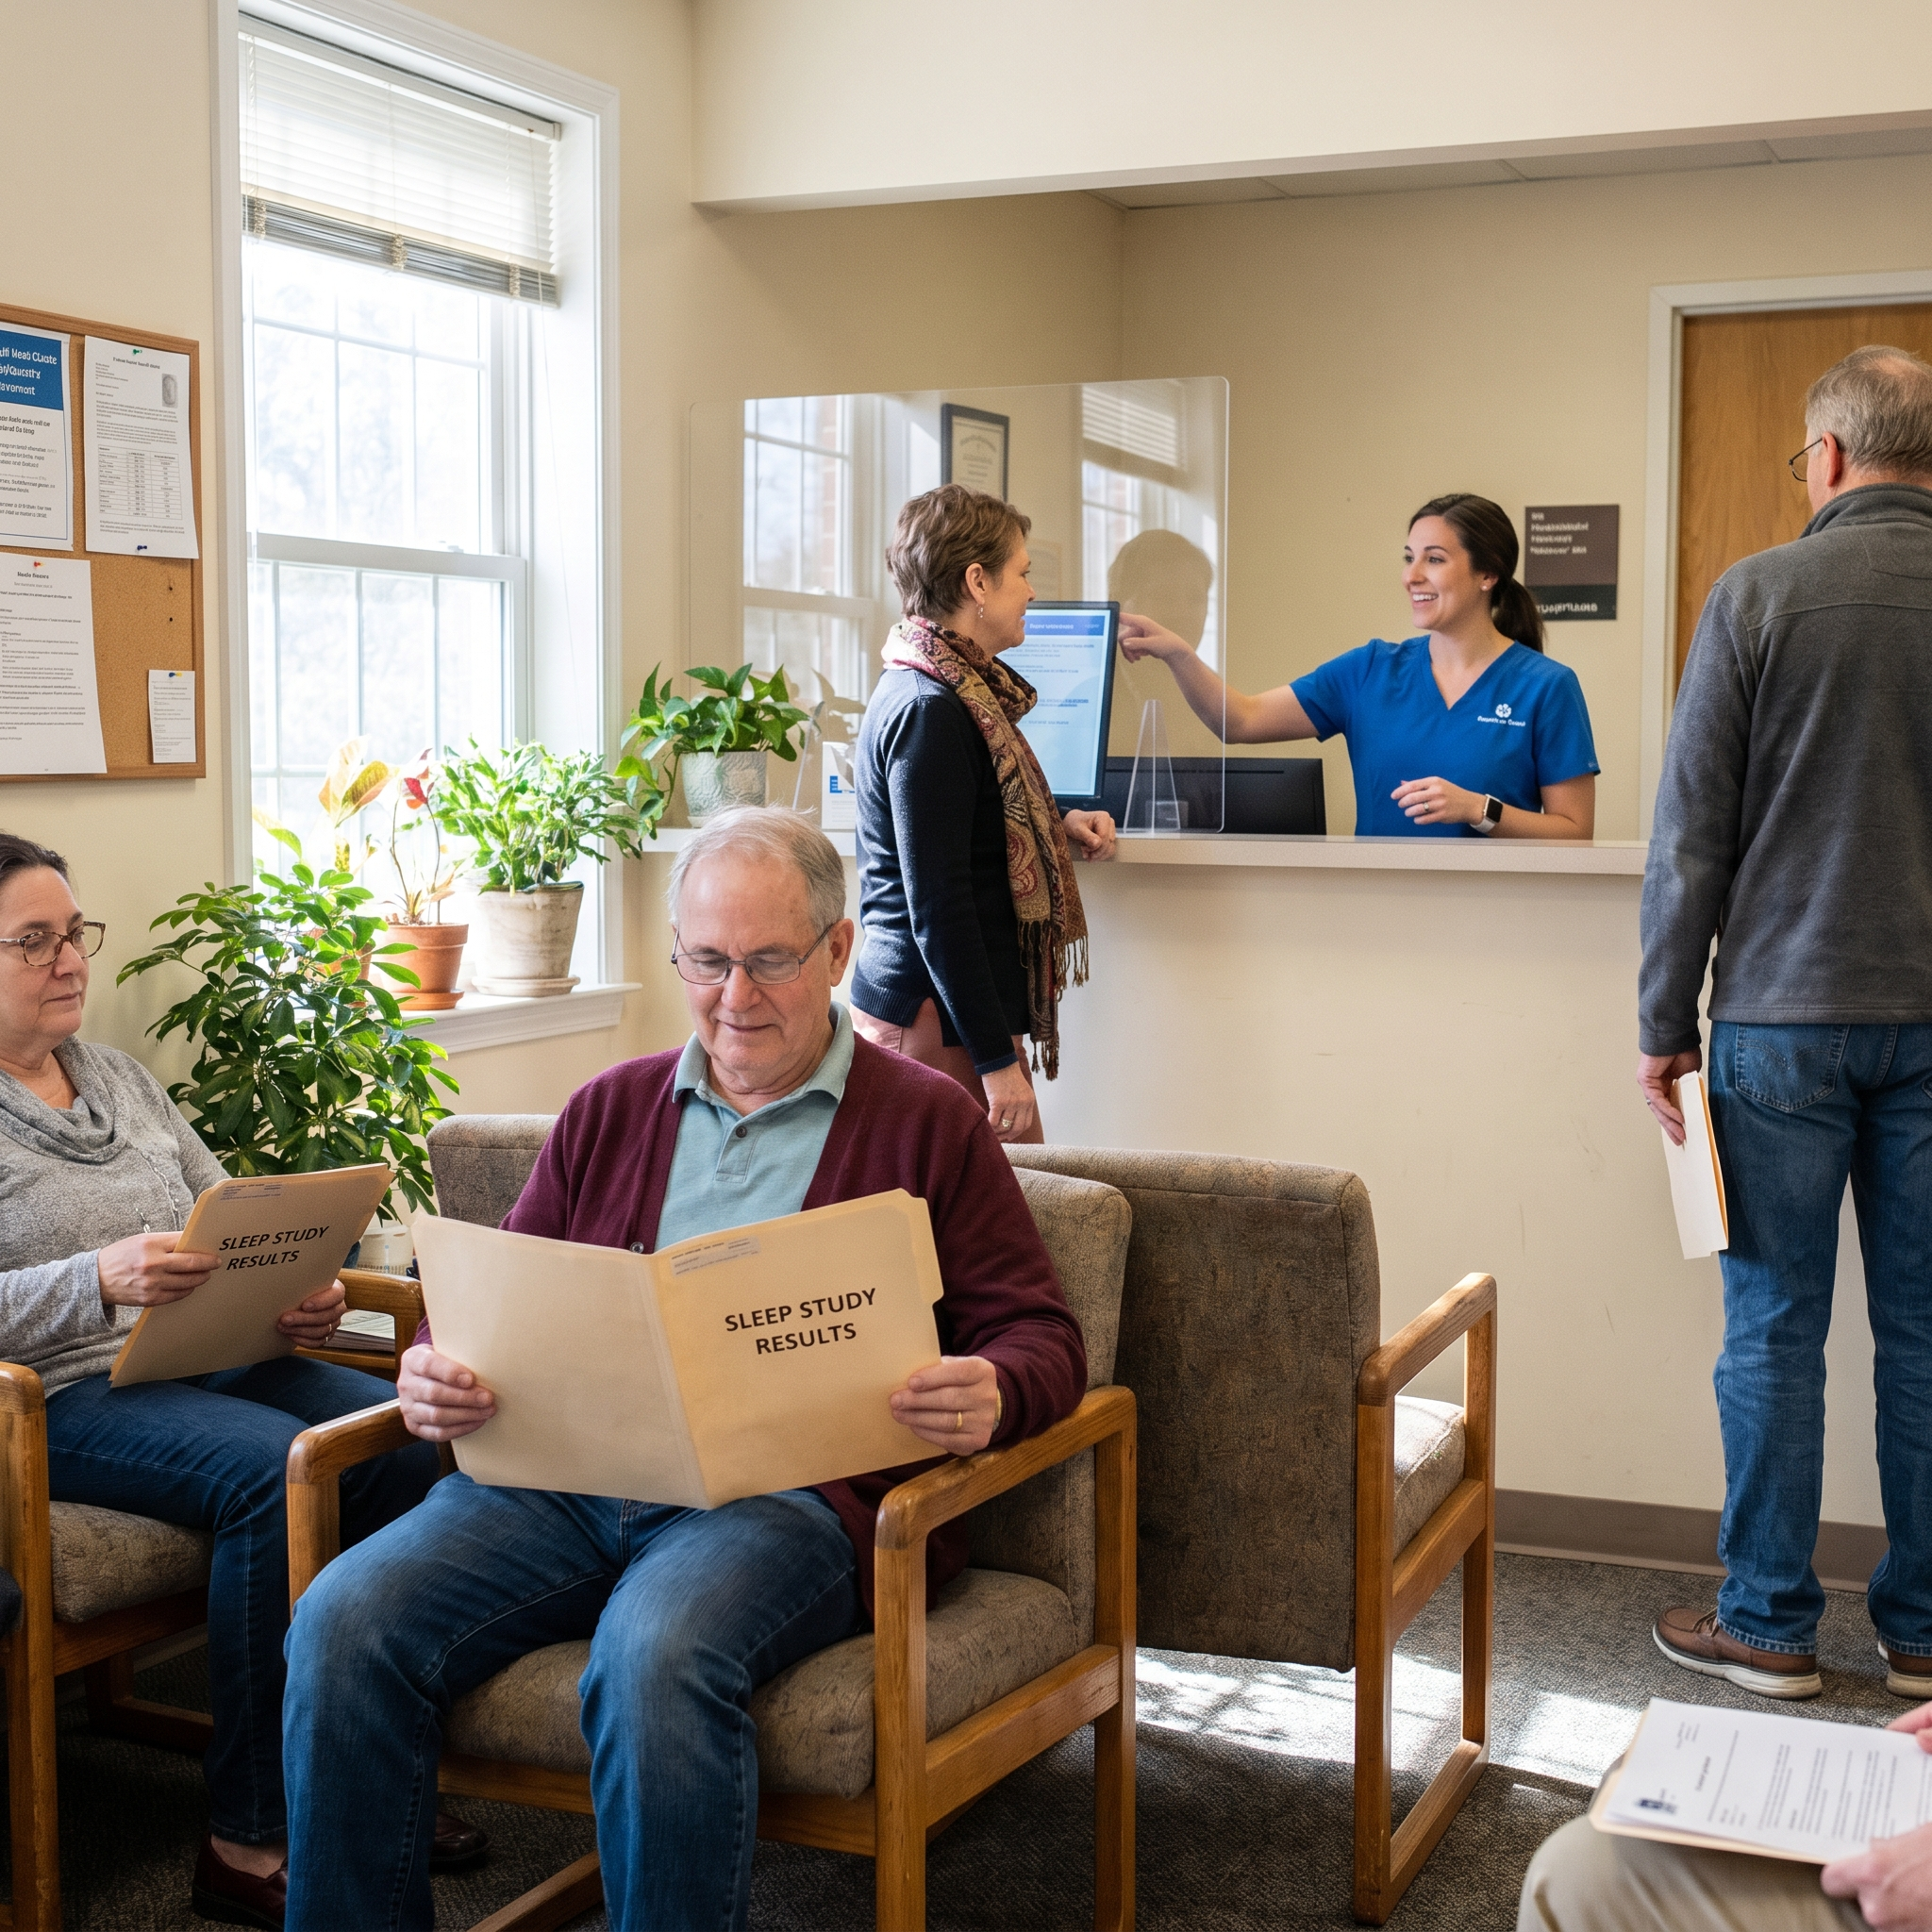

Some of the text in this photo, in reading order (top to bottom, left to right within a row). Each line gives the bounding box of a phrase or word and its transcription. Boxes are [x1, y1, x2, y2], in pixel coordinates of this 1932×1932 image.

[219, 1225, 329, 1251] SLEEP STUDY
[226, 1250, 300, 1271] RESULTS
[724, 1288, 876, 1332] SLEEP STUDY
[756, 1323, 858, 1355] RESULTS
